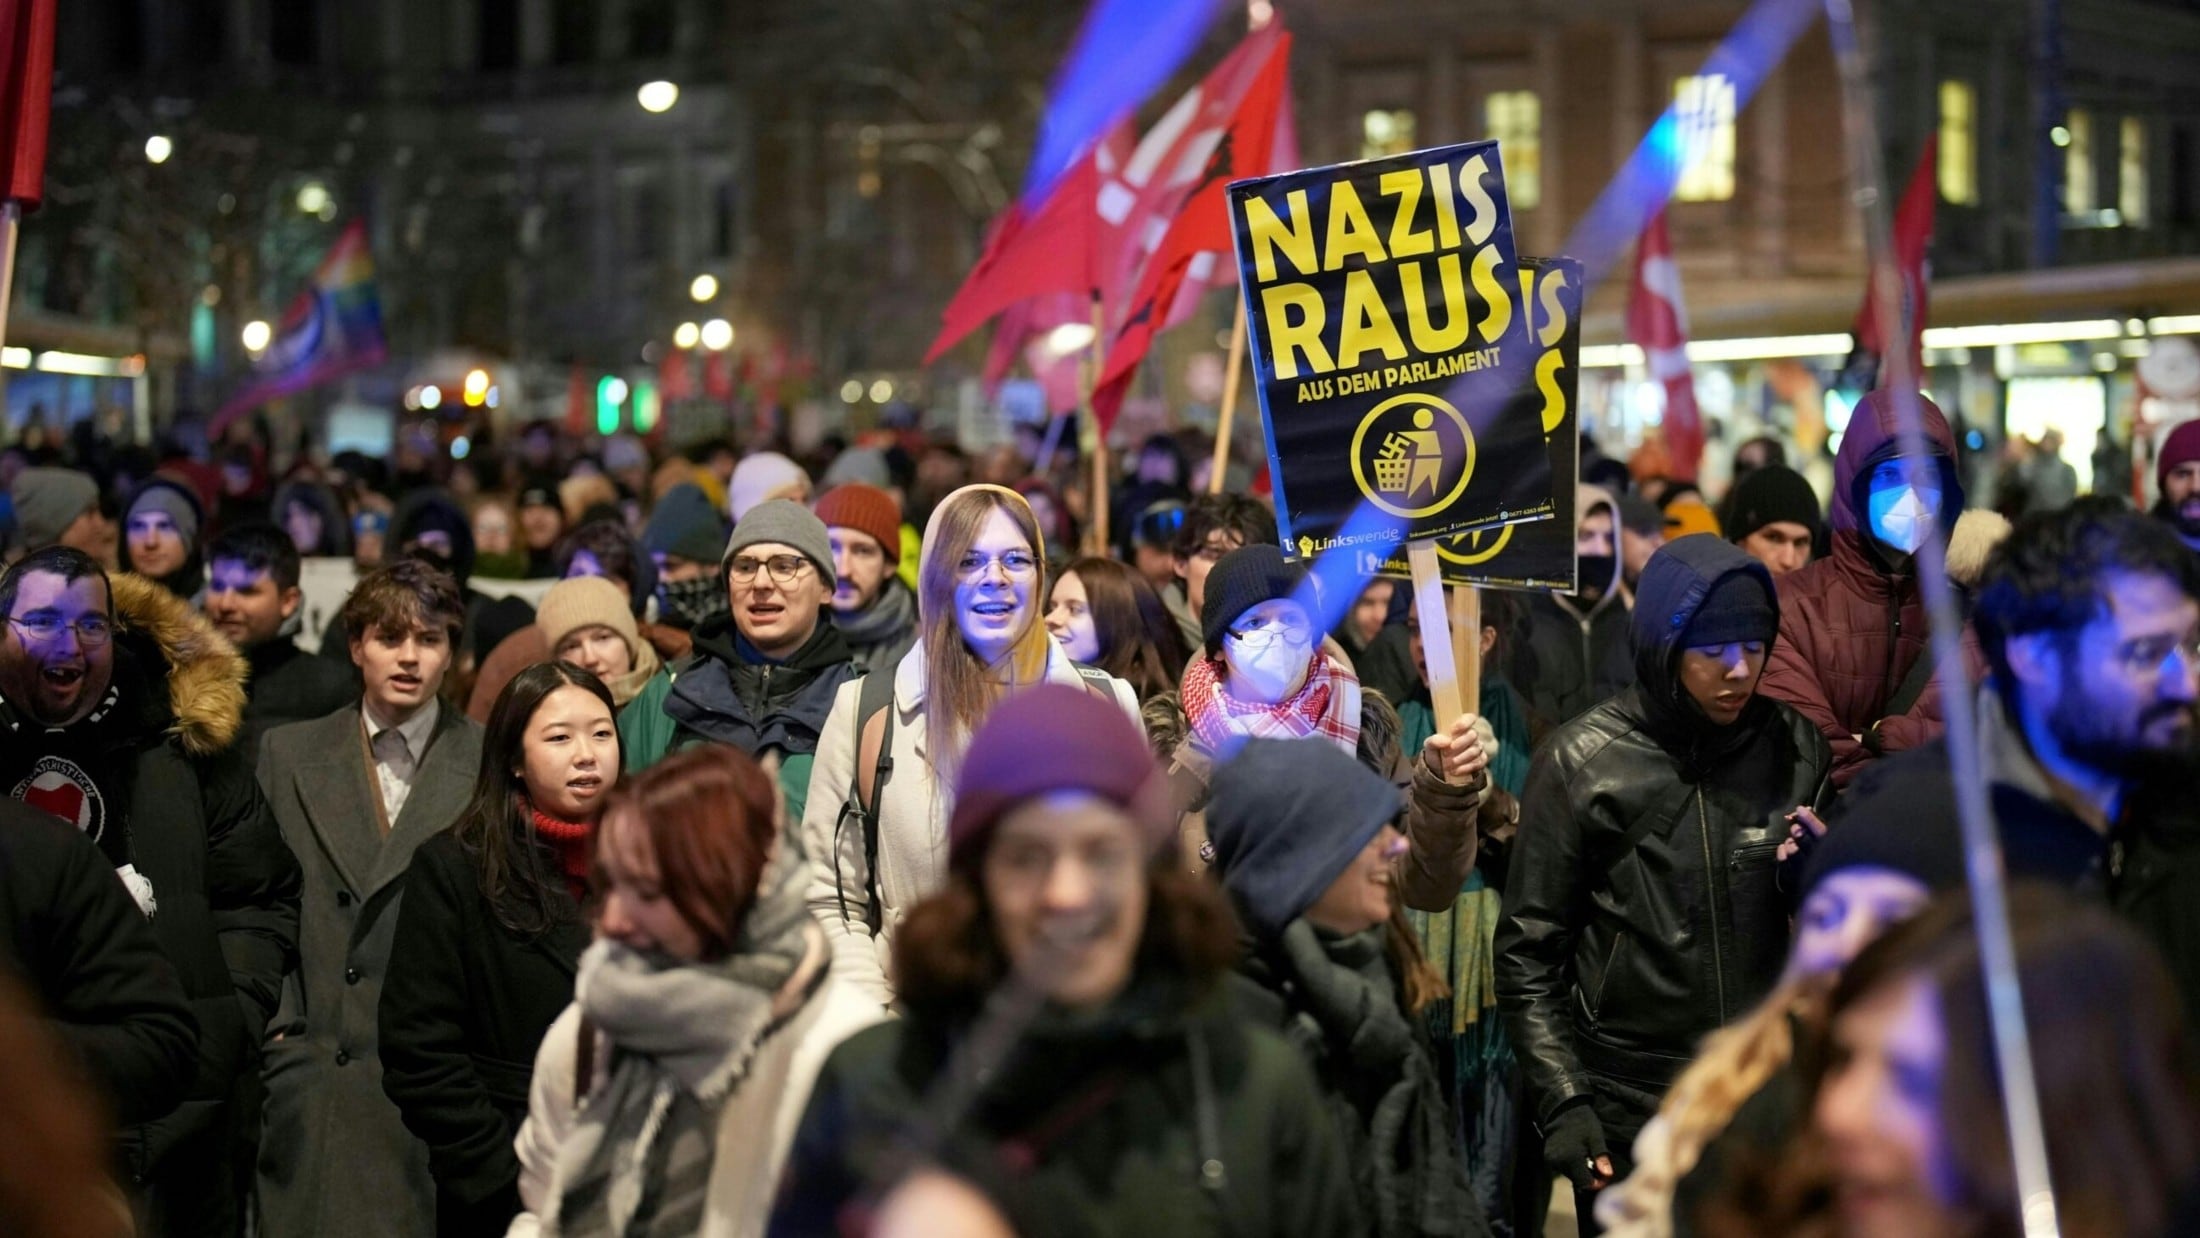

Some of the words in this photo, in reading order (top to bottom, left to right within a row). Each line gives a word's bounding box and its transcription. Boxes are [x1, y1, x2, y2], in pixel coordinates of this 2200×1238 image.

[1244, 154, 1498, 283] NAZIS
[1261, 243, 1513, 381] RAUS
[1297, 380, 1335, 404] AUS
[1337, 369, 1381, 397] DEM
[1385, 346, 1501, 389] PARLAMENT
[1314, 528, 1399, 551] Linkswende
